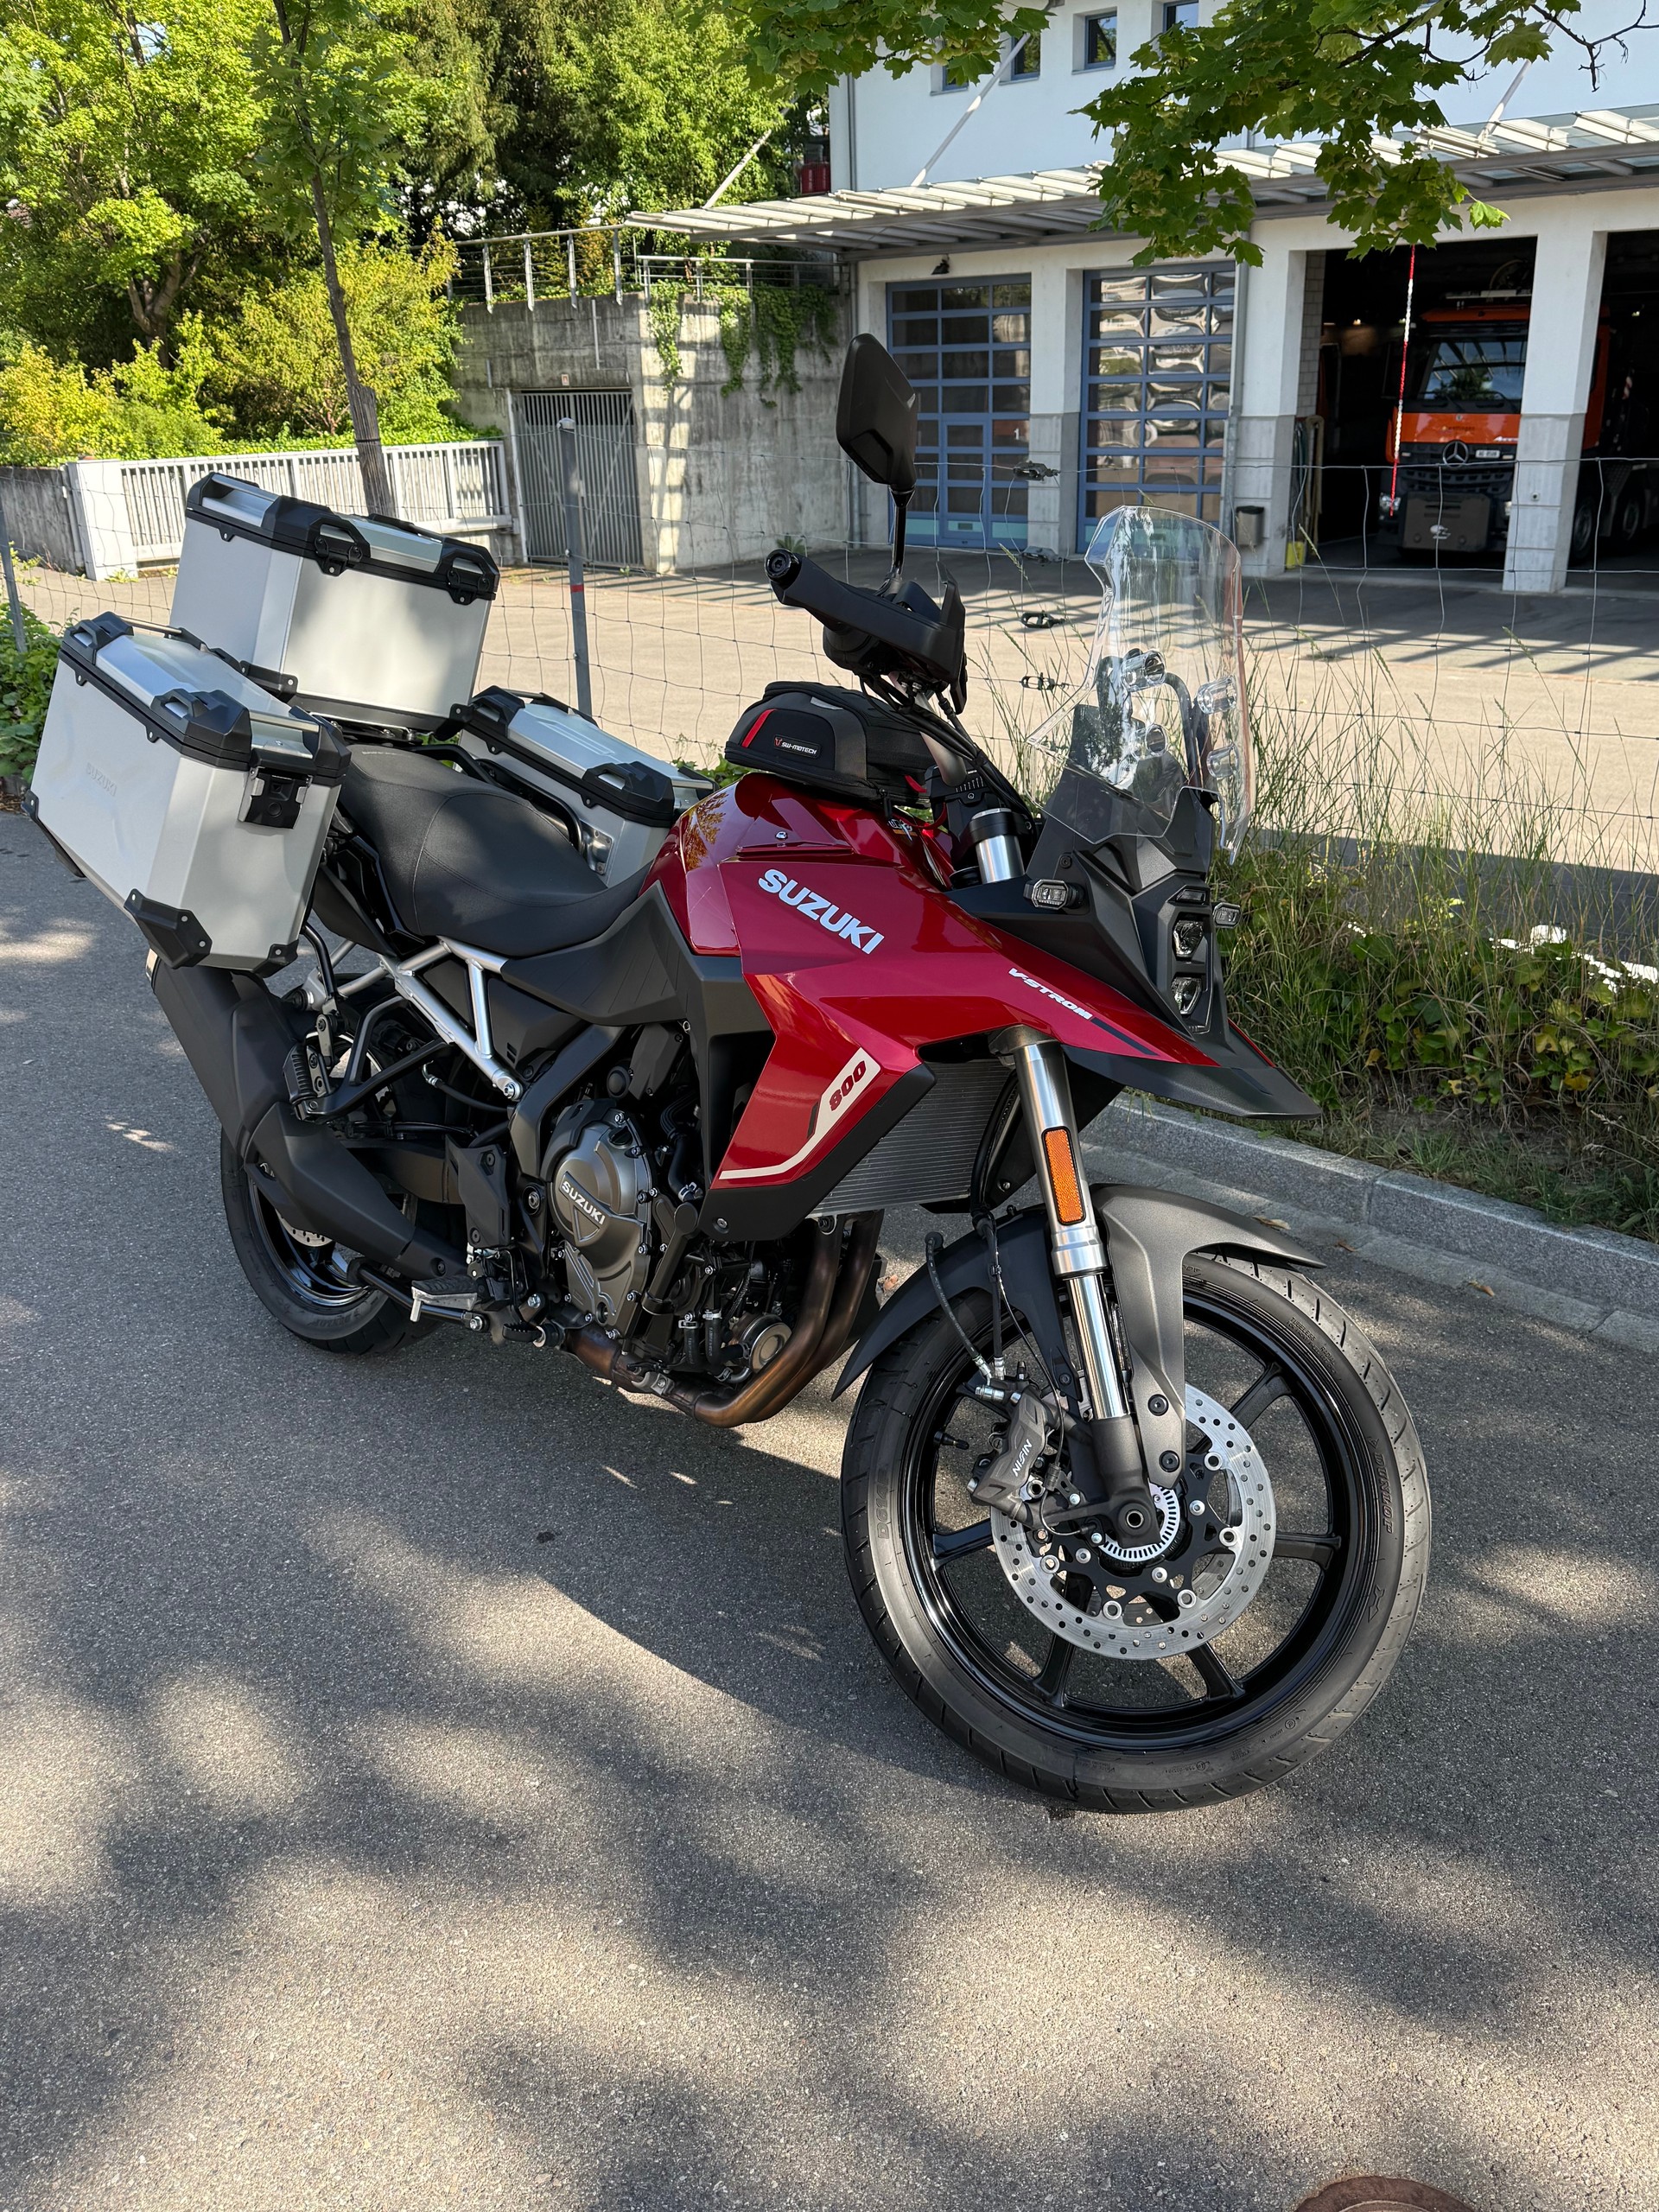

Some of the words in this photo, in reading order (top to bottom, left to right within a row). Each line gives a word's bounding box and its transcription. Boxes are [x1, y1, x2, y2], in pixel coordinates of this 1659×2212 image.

[781, 741, 817, 754] SW-MOTECH
[86, 761, 118, 797] SUZUKI
[758, 868, 885, 955] SUZUKI
[1008, 968, 1093, 1020] V-STROM
[830, 1060, 867, 1112] 800
[562, 1180, 606, 1225] SUZUKI
[1012, 1438, 1033, 1478] NISSIN
[1375, 1452, 1394, 1535] DUNLOP
